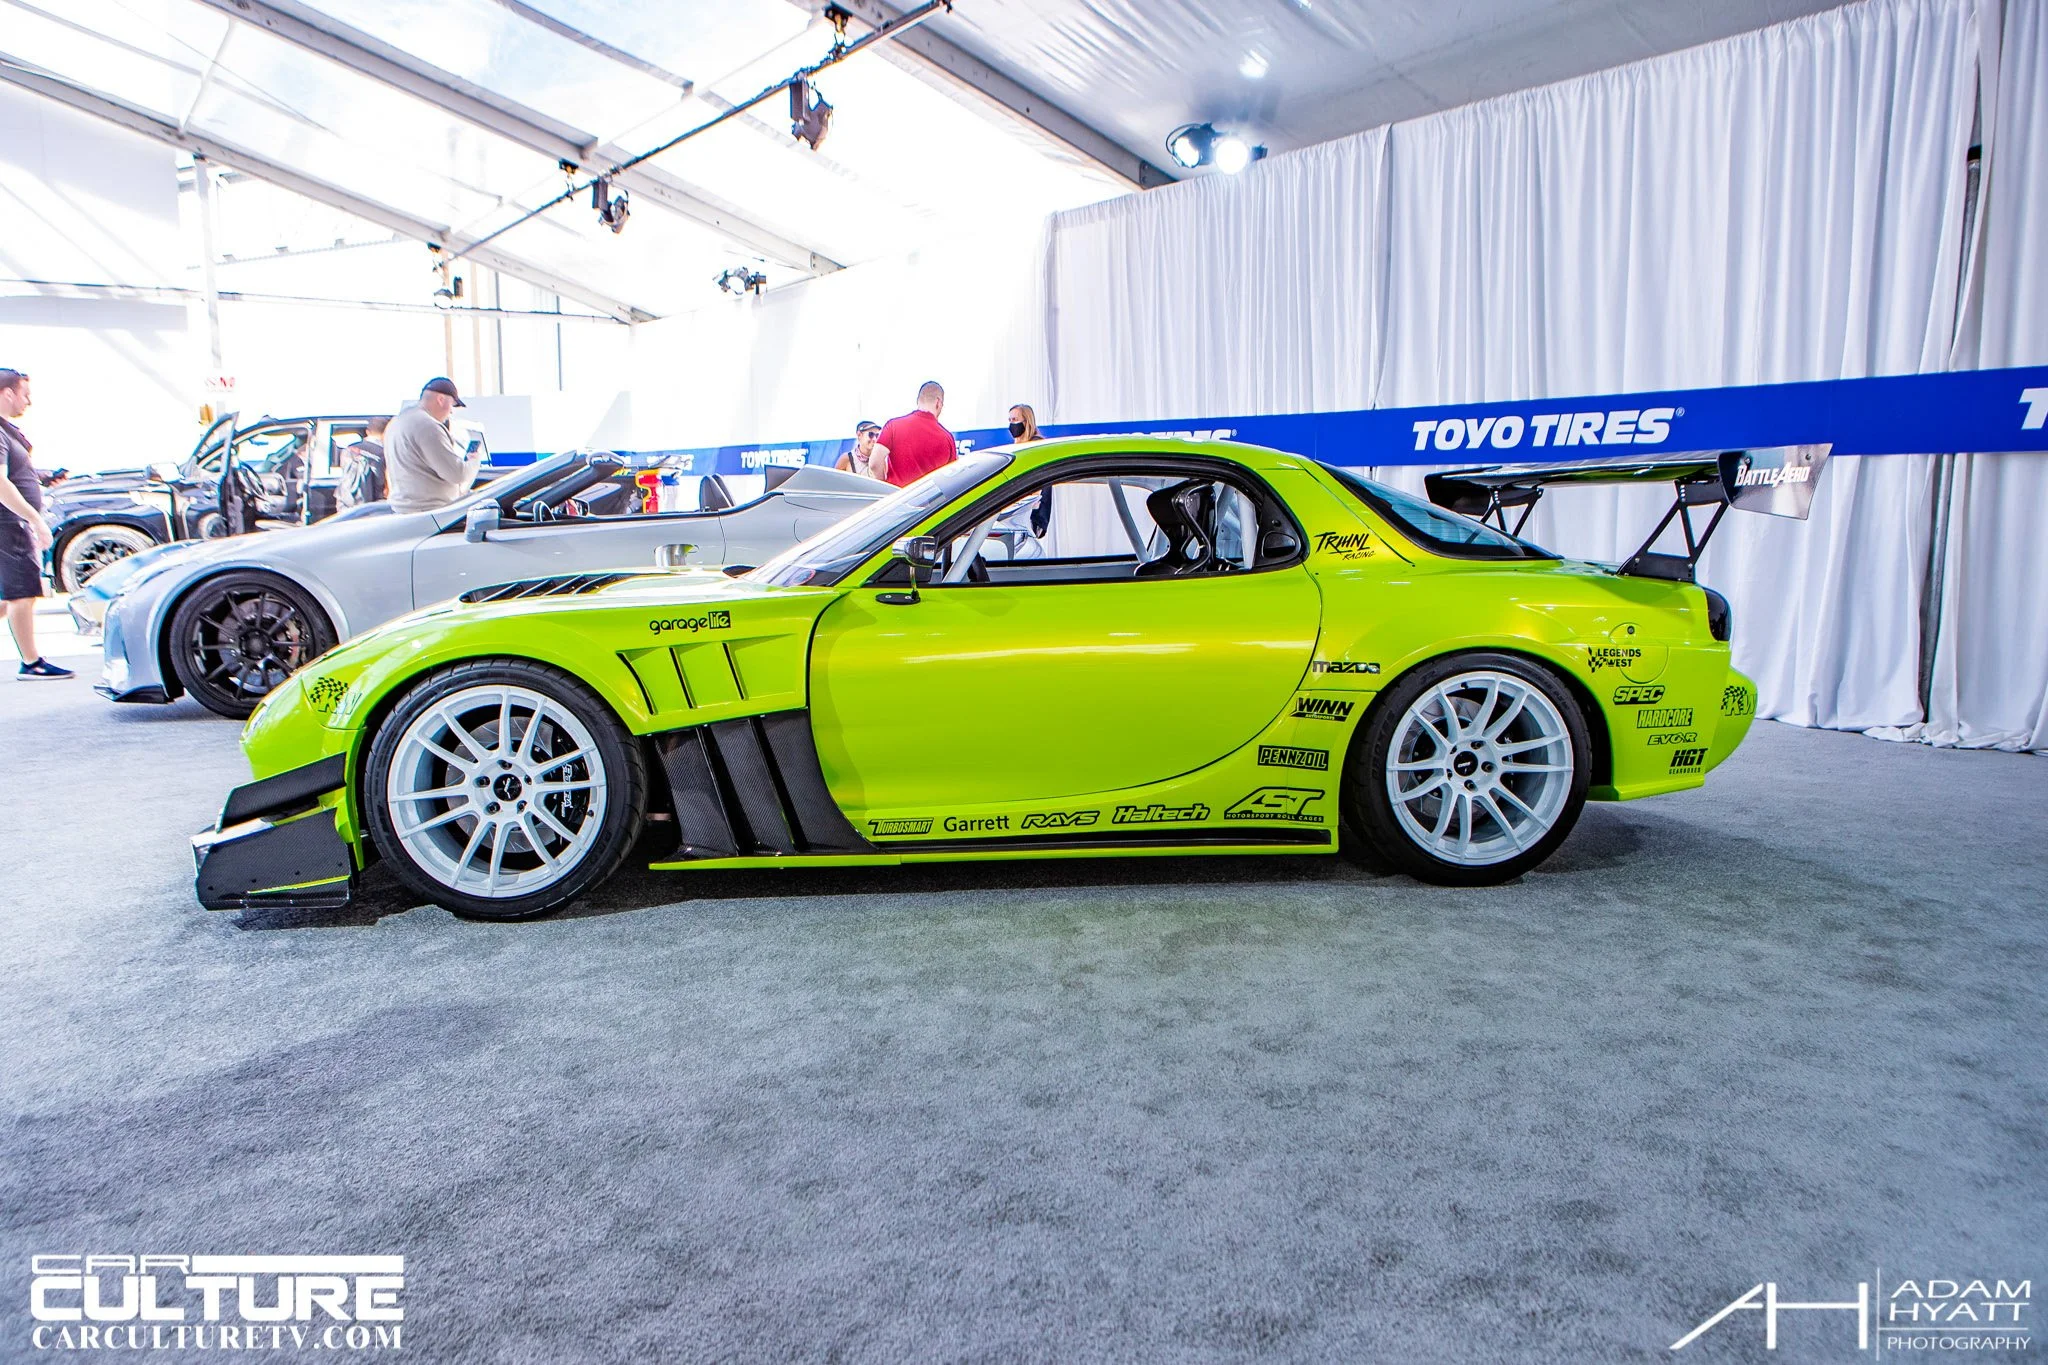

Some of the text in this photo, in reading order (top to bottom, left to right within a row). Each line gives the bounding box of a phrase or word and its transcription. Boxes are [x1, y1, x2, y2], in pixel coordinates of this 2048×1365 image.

[1412, 416, 1525, 451] TOYO
[1597, 648, 1641, 657] LEGENDS
[1606, 658, 1632, 667] WEST
[1613, 685, 1665, 705] SPEC
[1297, 697, 1355, 716] WINN
[1637, 708, 1693, 728] HARDCORE
[1259, 746, 1328, 769] PENNZOIL
[1670, 748, 1708, 767] HGT
[1022, 811, 1099, 828] RAYS
[1112, 804, 1210, 823] Haltech
[869, 817, 933, 835] TURBOSMART
[943, 816, 1009, 832] Garrett
